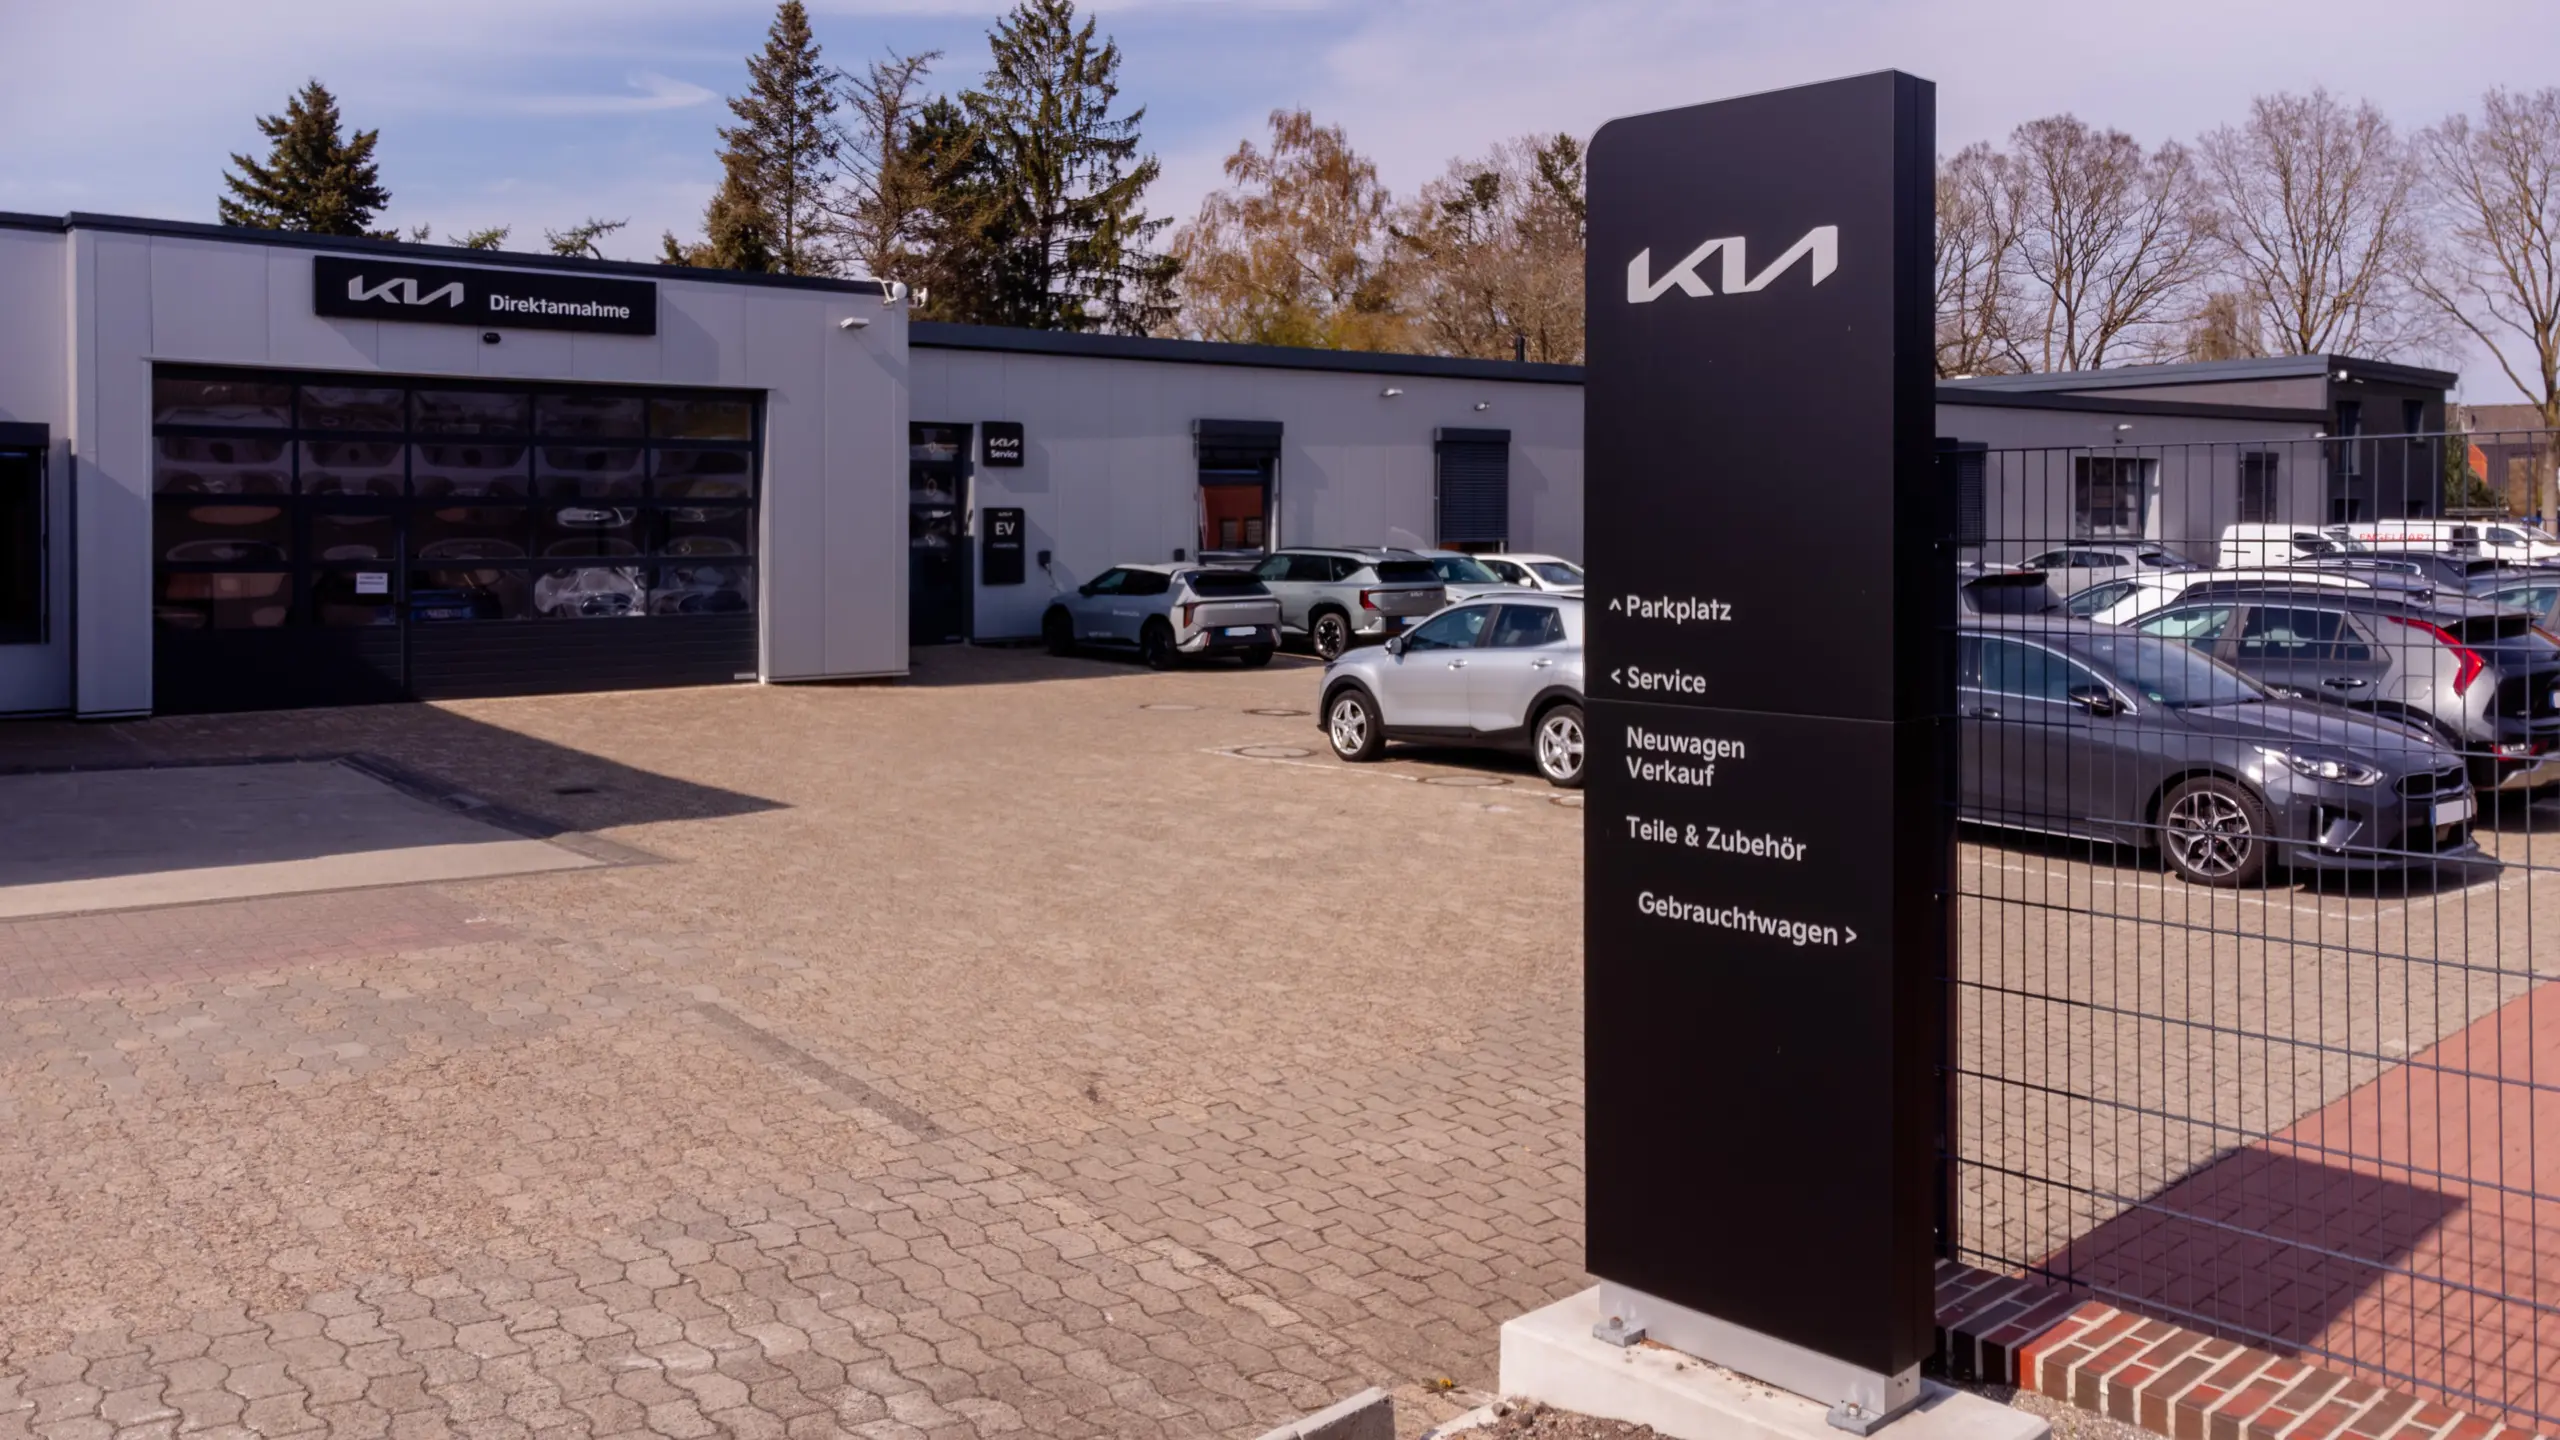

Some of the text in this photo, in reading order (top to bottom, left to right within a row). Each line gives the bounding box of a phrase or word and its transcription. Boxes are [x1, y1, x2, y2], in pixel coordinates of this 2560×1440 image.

[1627, 224, 1838, 303] KIA
[348, 275, 464, 308] KIA
[490, 294, 630, 319] Direktannahme
[990, 449, 1018, 459] Service
[995, 521, 1015, 536] EV
[1626, 595, 1732, 625] Parkplatz
[1627, 666, 1706, 693] Service
[1626, 726, 1745, 762] Neuwagen
[1626, 755, 1715, 787] Verkauf
[1626, 815, 1807, 861] Teile & Zubehör
[1638, 891, 1838, 946] Gebrauchtwagen
